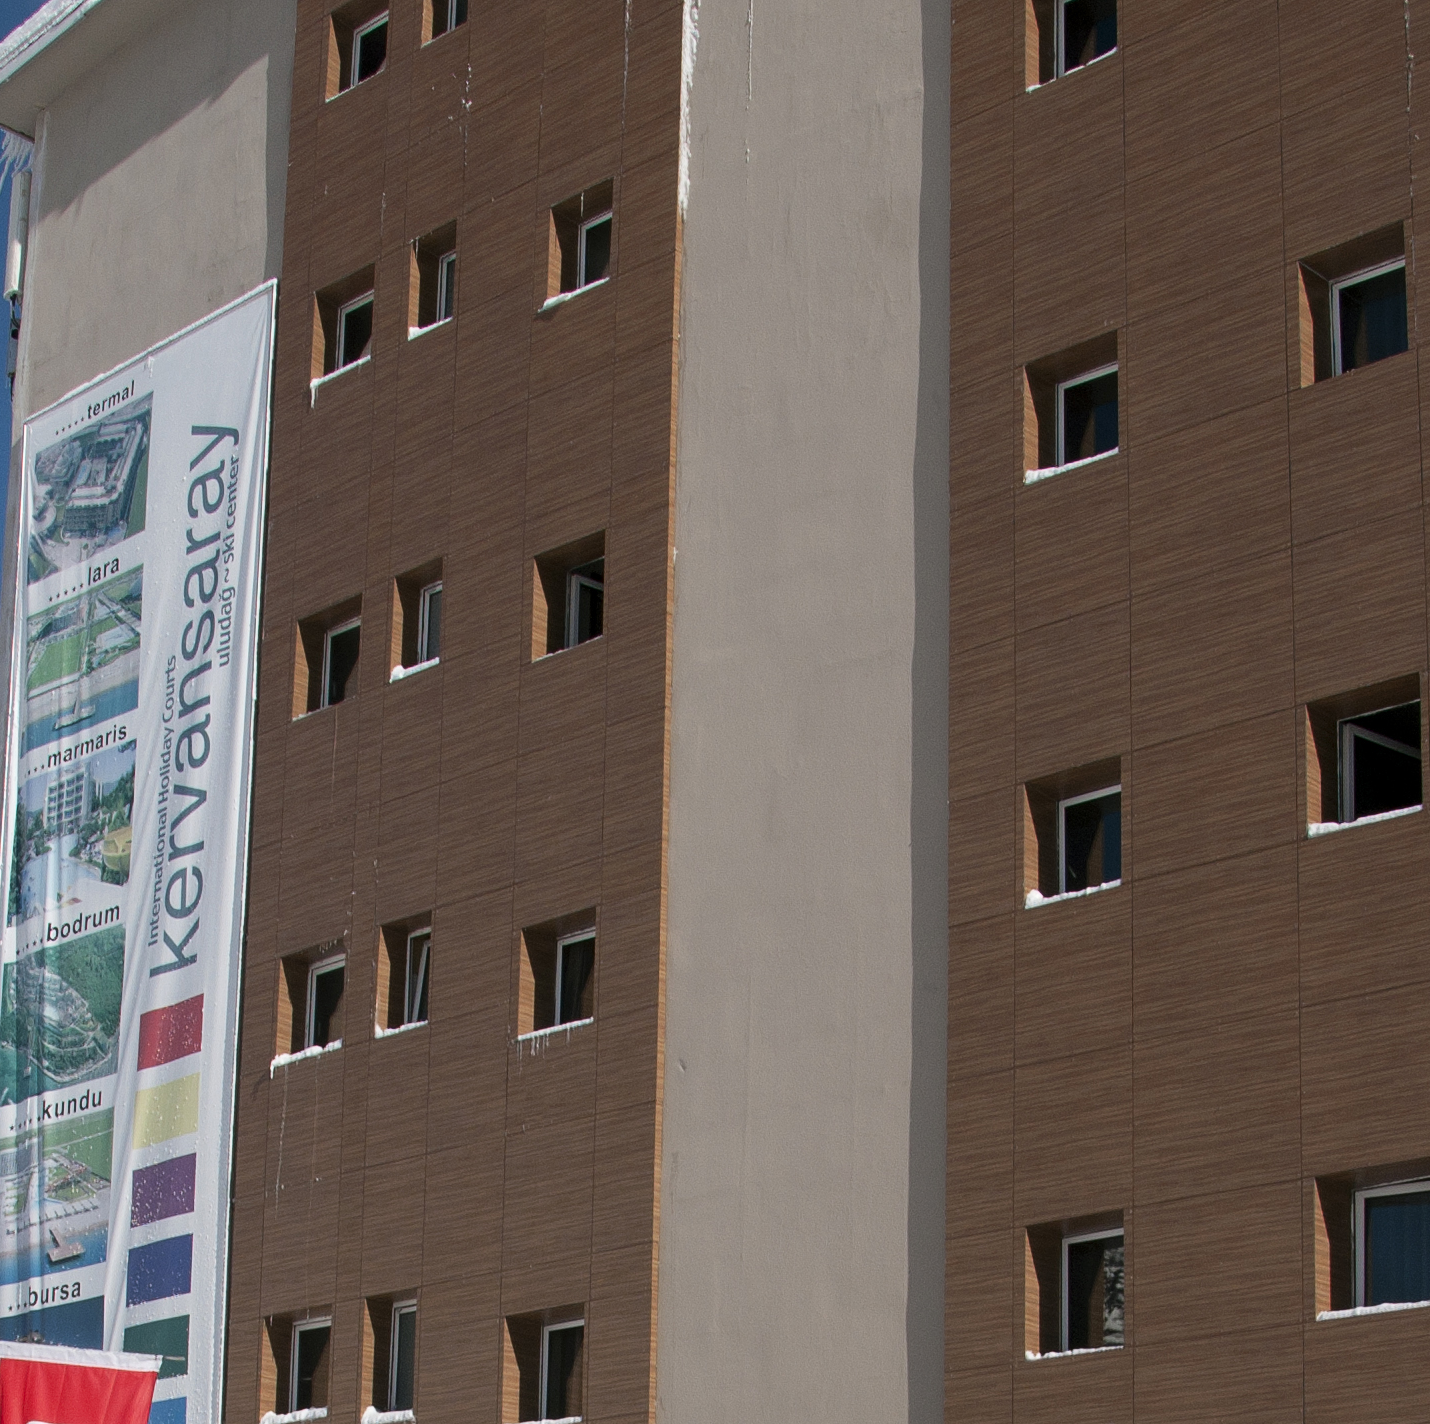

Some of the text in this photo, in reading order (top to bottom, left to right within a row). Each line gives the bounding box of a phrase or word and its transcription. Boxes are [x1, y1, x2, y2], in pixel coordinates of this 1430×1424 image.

[87, 379, 135, 420] termal
[225, 454, 240, 530] center
[222, 533, 235, 565] ski
[87, 557, 120, 586] lara
[216, 585, 236, 668] uludağ
[149, 425, 240, 979] kervansaray
[47, 723, 127, 769] marmaris
[148, 655, 177, 948] International Holiday Courts
[46, 904, 120, 942] bodrum
[42, 1088, 102, 1122] kundu
[28, 1281, 82, 1307] bursa
